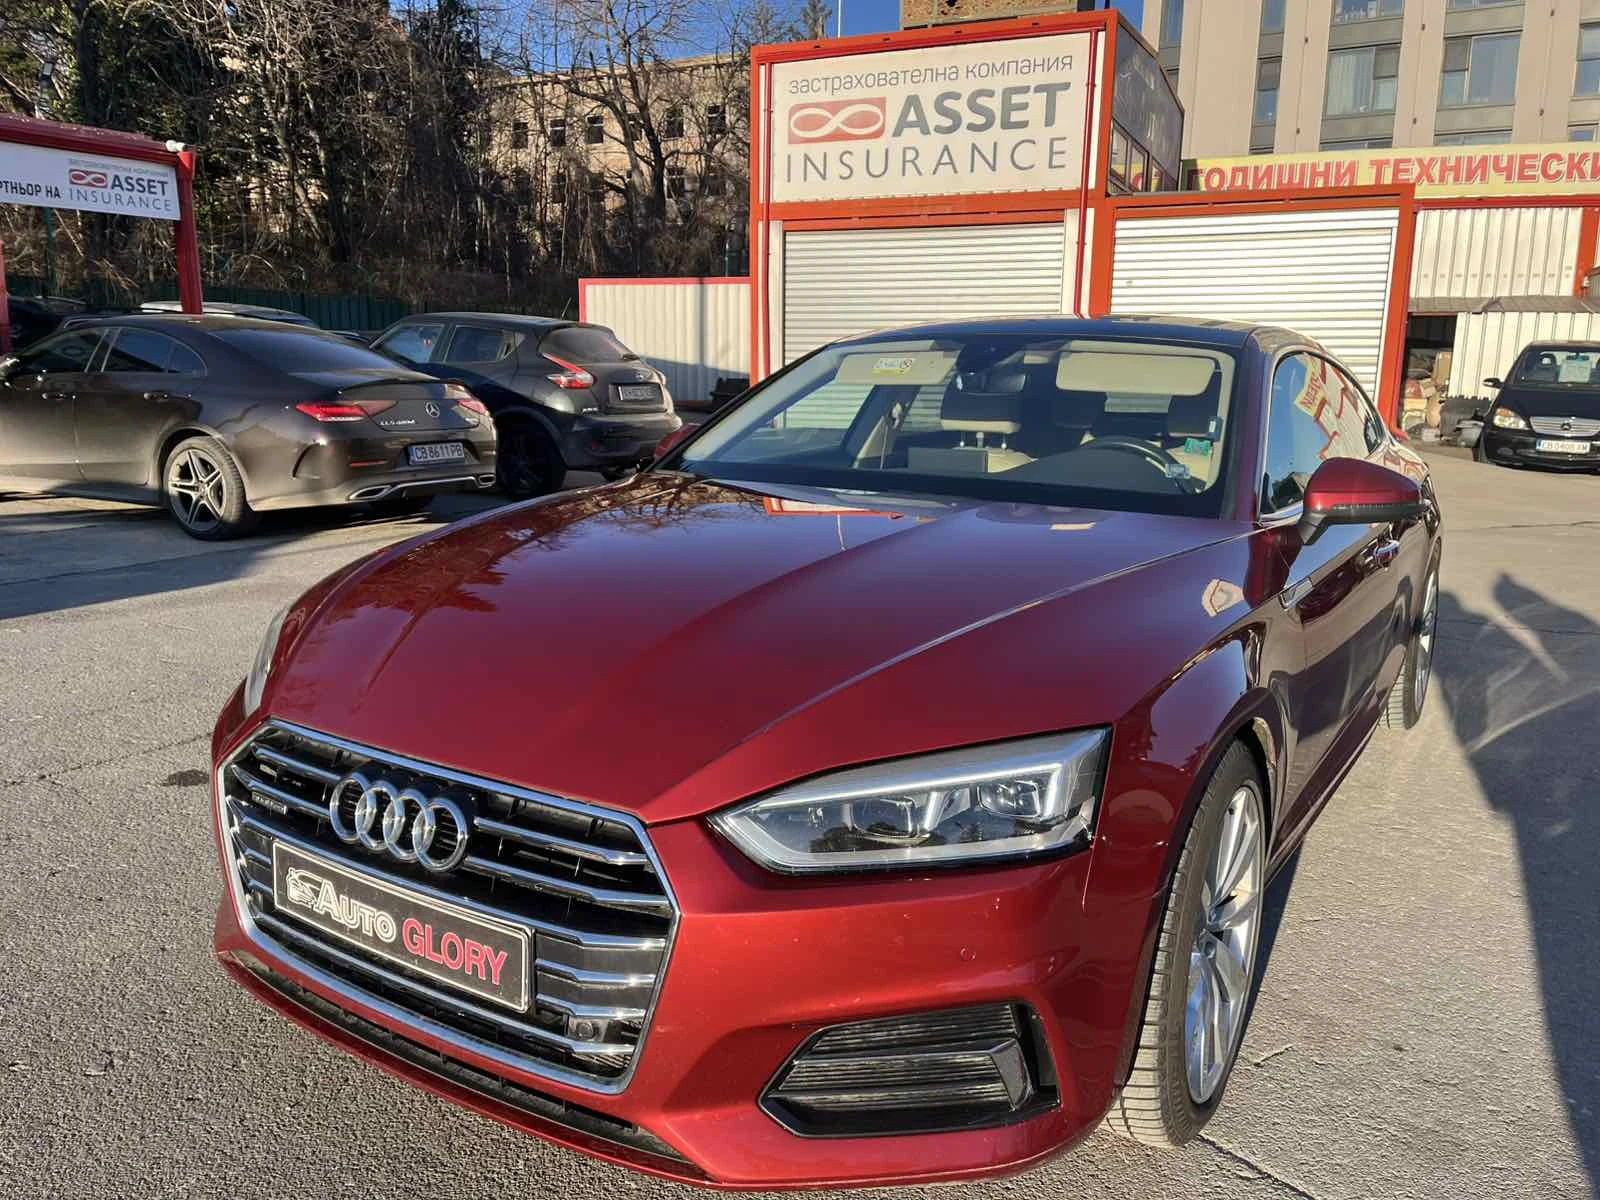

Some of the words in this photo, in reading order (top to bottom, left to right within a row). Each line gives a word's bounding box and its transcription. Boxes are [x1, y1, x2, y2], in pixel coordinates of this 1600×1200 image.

[789, 67, 959, 96] застрахователна
[966, 55, 1073, 79] компания
[892, 82, 1071, 138] ASSET
[787, 137, 1067, 183] INSURANCE
[45, 186, 62, 199] НА
[69, 187, 173, 212] INSURANCE
[111, 174, 169, 197] ASSET
[313, 878, 397, 943] AUTO
[402, 918, 508, 985] GLORY
